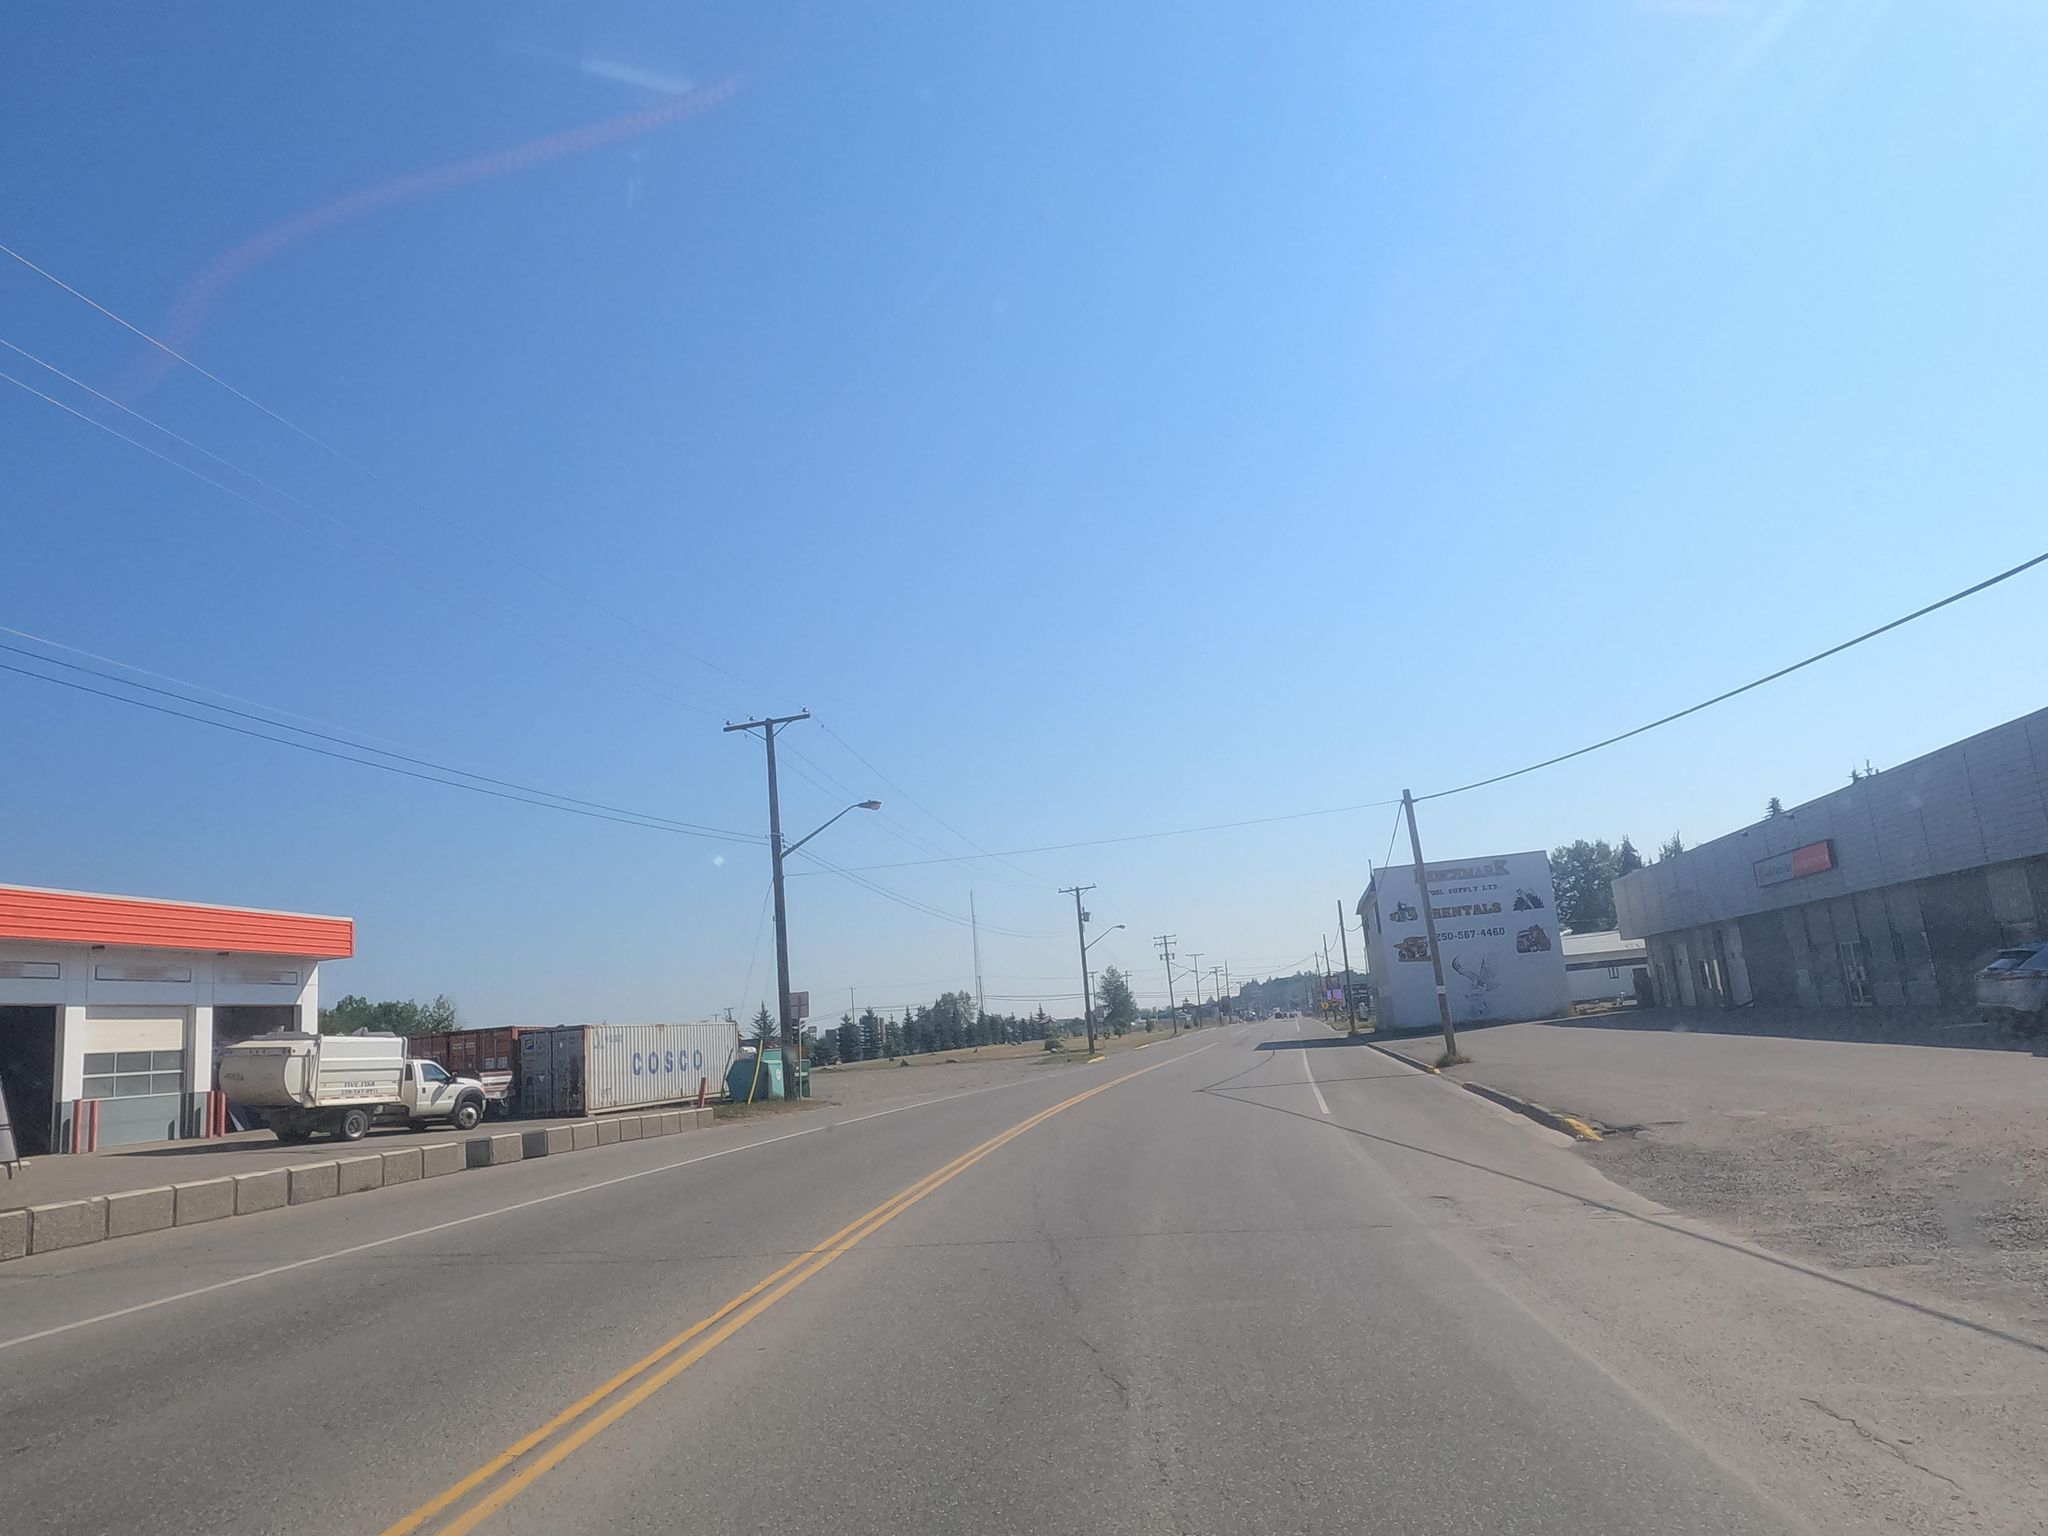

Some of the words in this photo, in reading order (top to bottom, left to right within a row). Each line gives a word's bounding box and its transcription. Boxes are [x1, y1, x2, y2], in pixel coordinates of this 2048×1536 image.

[1447, 886, 1478, 895] SUPPLY
[1432, 902, 1502, 919] RENTALS
[1436, 927, 1505, 941] 250-567-4460
[632, 1049, 703, 1076] COSCO
